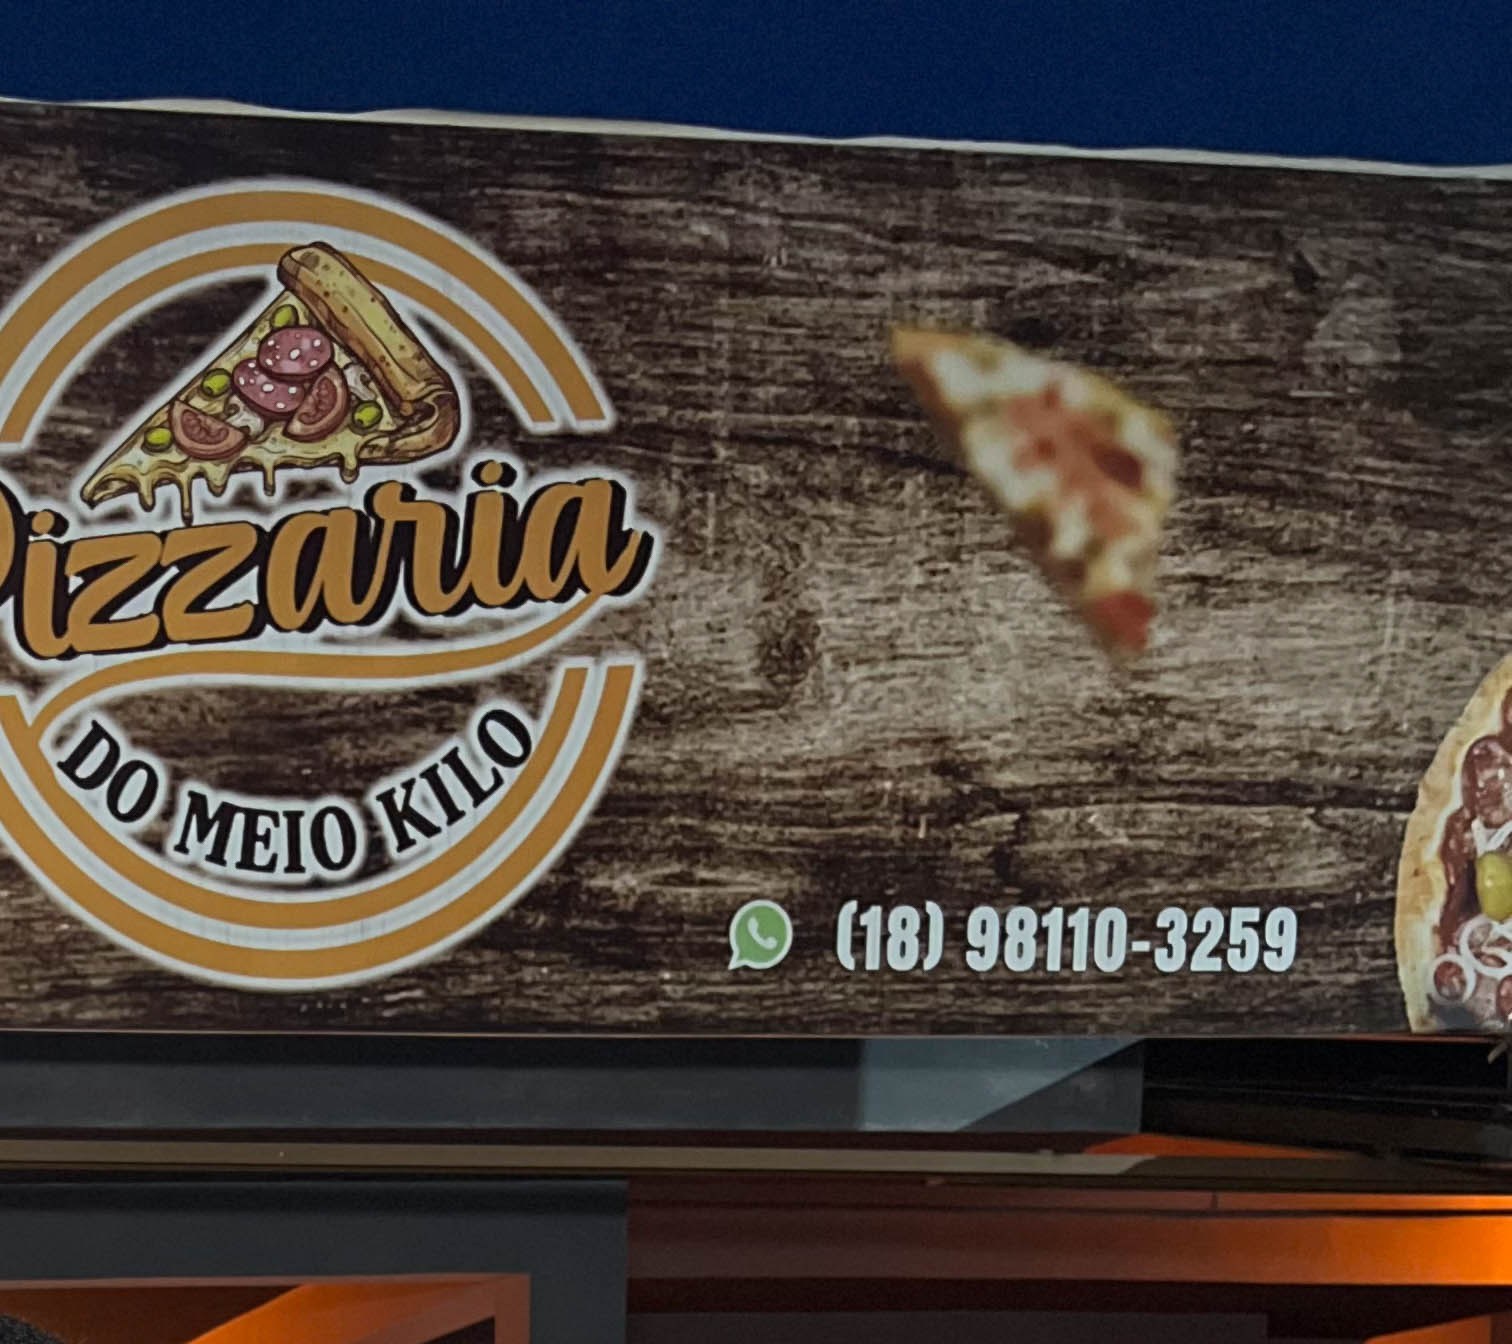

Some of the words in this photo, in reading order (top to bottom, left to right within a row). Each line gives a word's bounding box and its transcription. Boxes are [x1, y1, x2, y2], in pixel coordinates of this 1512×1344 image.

[57, 720, 158, 823] DO
[174, 790, 356, 873] MEIO
[376, 709, 532, 853] KILO
[836, 900, 944, 971] (18)
[965, 906, 1298, 972] 98110-3259
